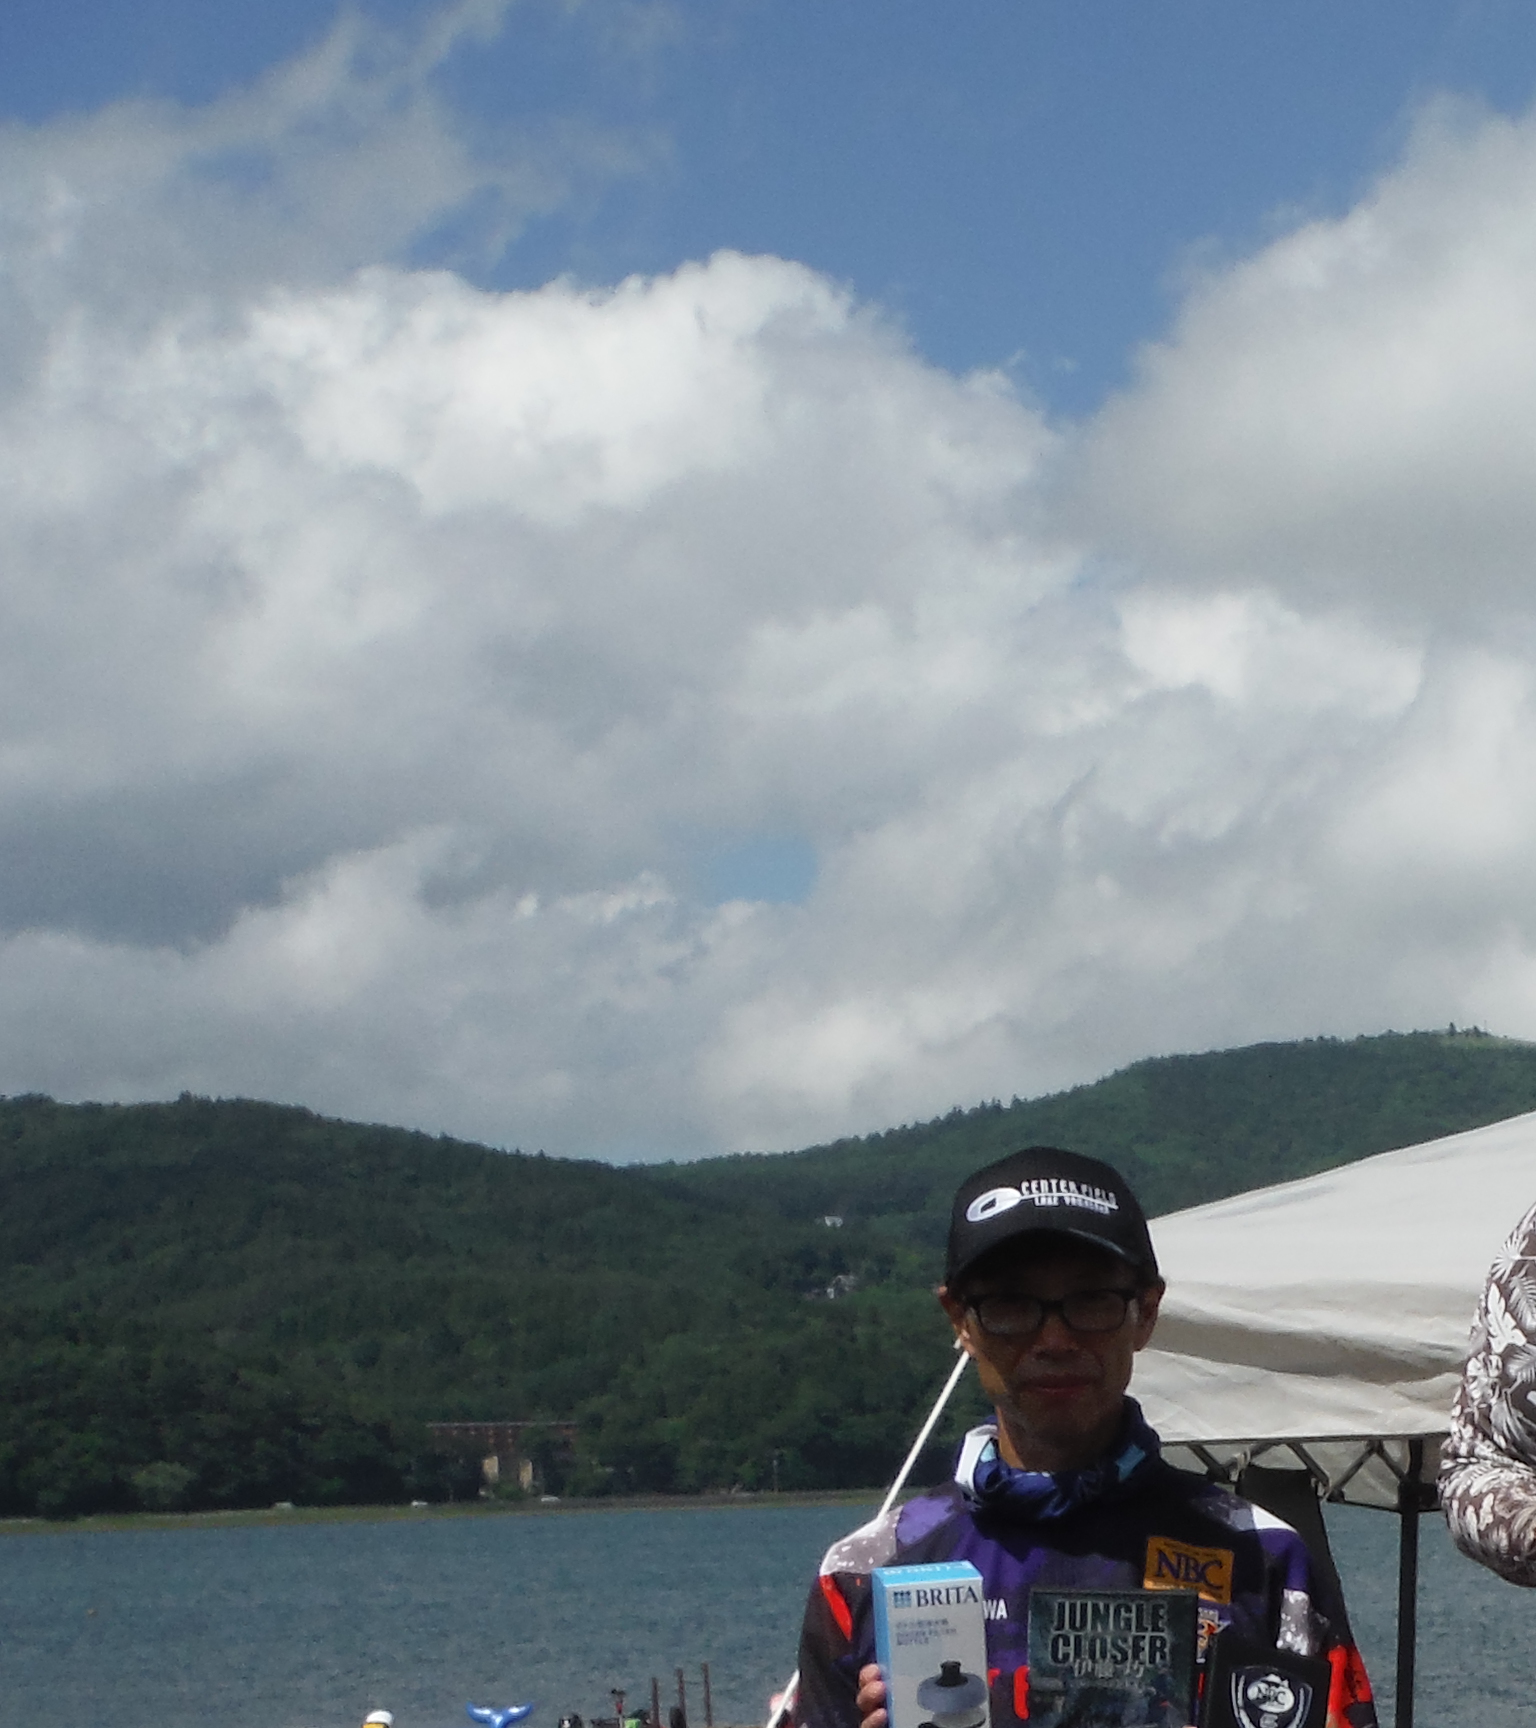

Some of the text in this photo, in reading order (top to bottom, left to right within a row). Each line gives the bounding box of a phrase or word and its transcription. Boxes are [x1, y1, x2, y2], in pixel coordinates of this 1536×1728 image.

[1154, 1548, 1224, 1591] NBC
[916, 1586, 979, 1608] BRITA
[1052, 1600, 1168, 1633] JUNGLE
[1049, 1633, 1170, 1666] CLOSER
